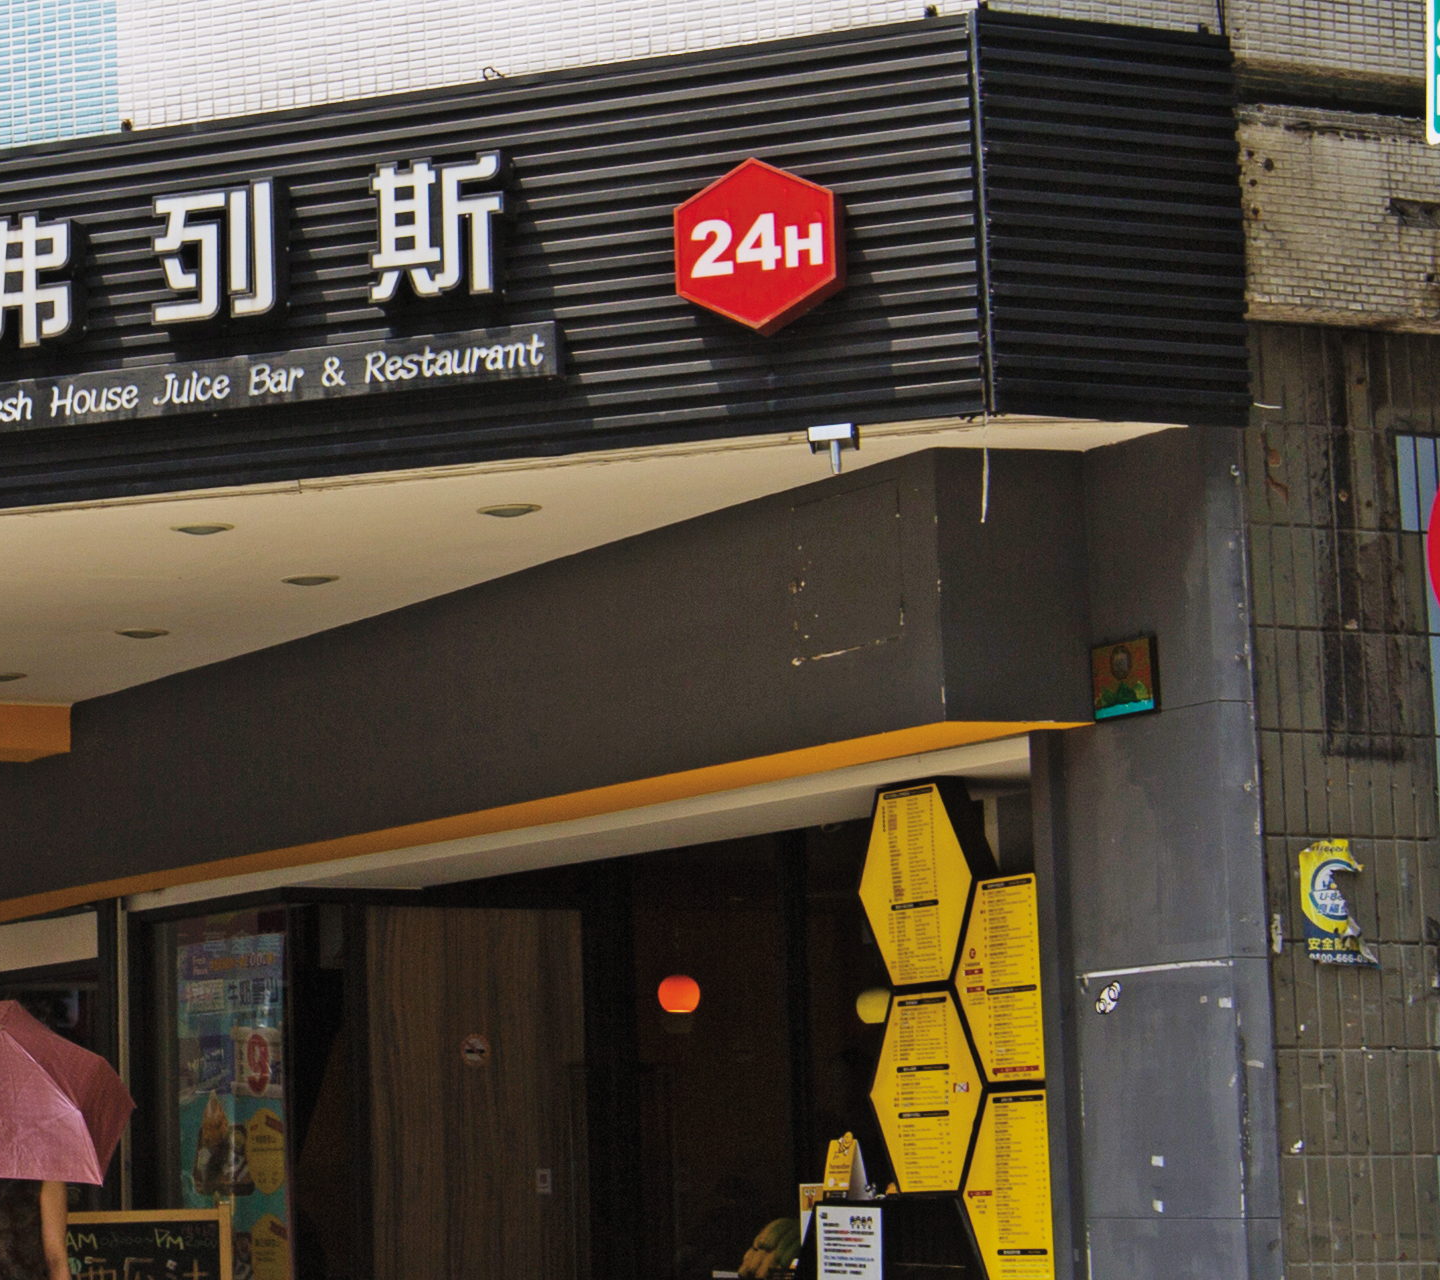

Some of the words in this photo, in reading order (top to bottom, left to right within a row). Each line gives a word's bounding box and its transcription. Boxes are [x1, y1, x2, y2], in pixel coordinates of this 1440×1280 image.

[691, 212, 824, 278] 24H
[51, 384, 139, 419] House
[152, 371, 230, 406] Juice
[249, 363, 305, 396] Bar
[322, 356, 346, 388] &
[365, 333, 545, 385] Restaurant
